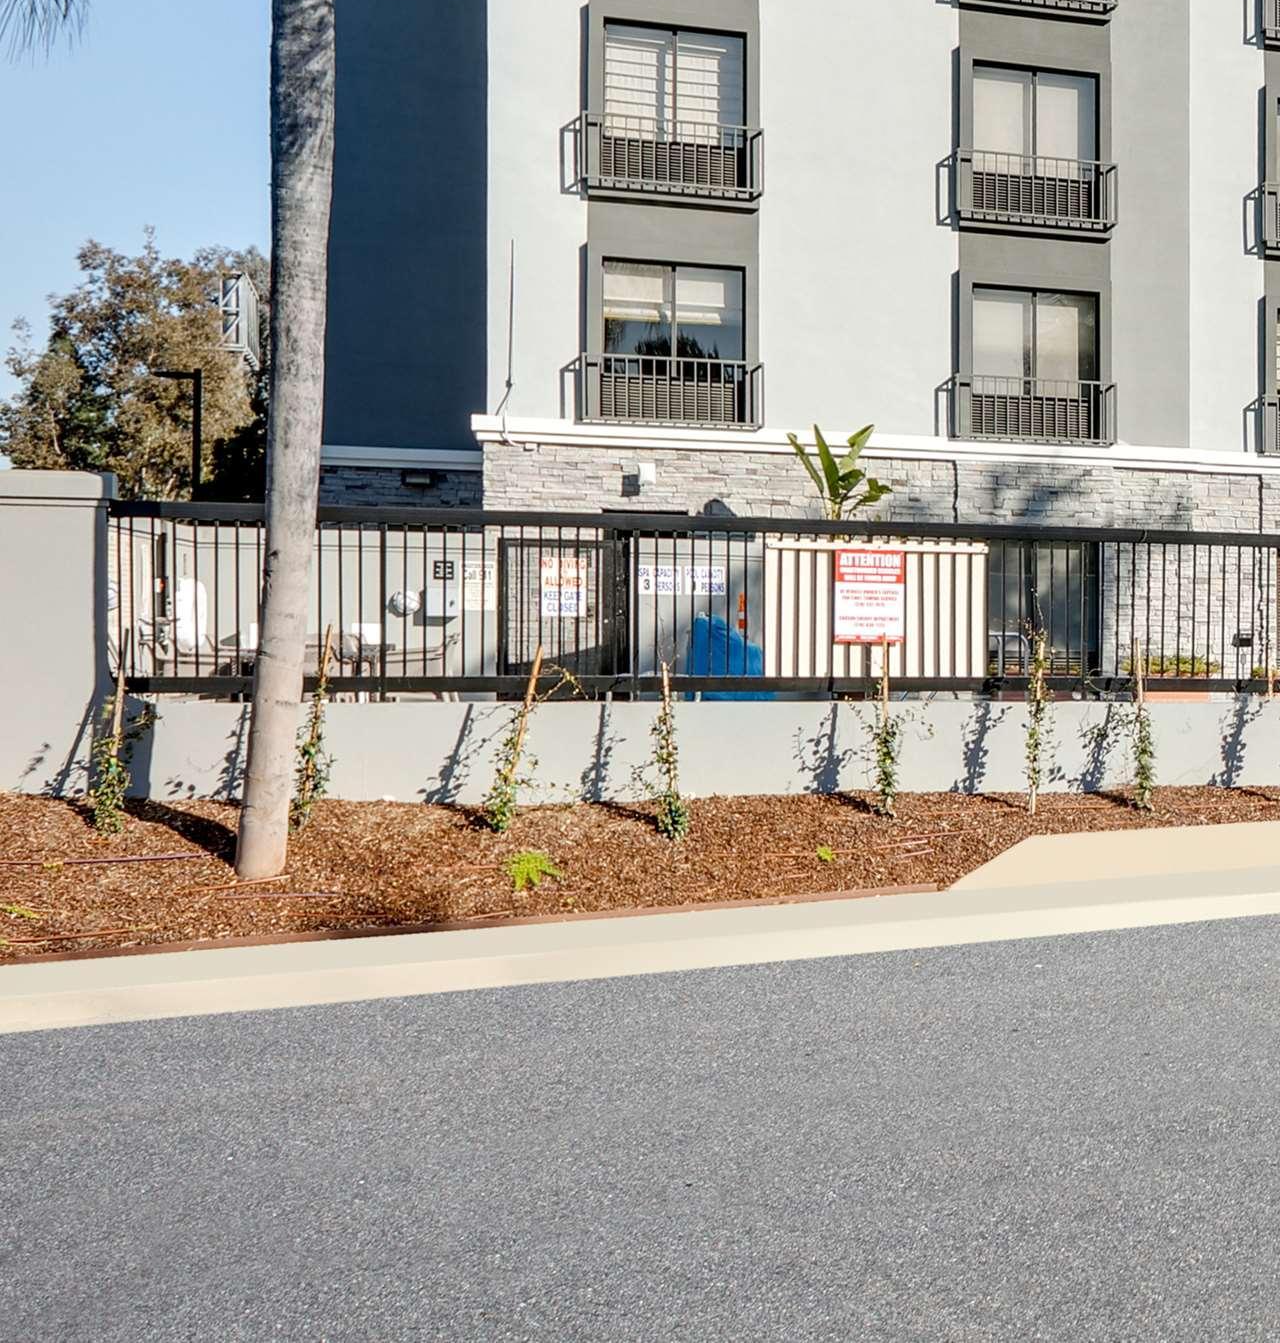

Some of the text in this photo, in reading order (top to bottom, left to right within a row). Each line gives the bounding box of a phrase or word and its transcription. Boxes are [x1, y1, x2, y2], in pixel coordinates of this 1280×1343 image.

[840, 553, 900, 567] ATTENTION
[544, 575, 583, 587] ALLOWED
[643, 579, 651, 591] 3
[655, 580, 680, 592] ERSOS
[701, 582, 724, 593] PESONS
[543, 590, 561, 601] KEE
[546, 602, 579, 613] CLSED
